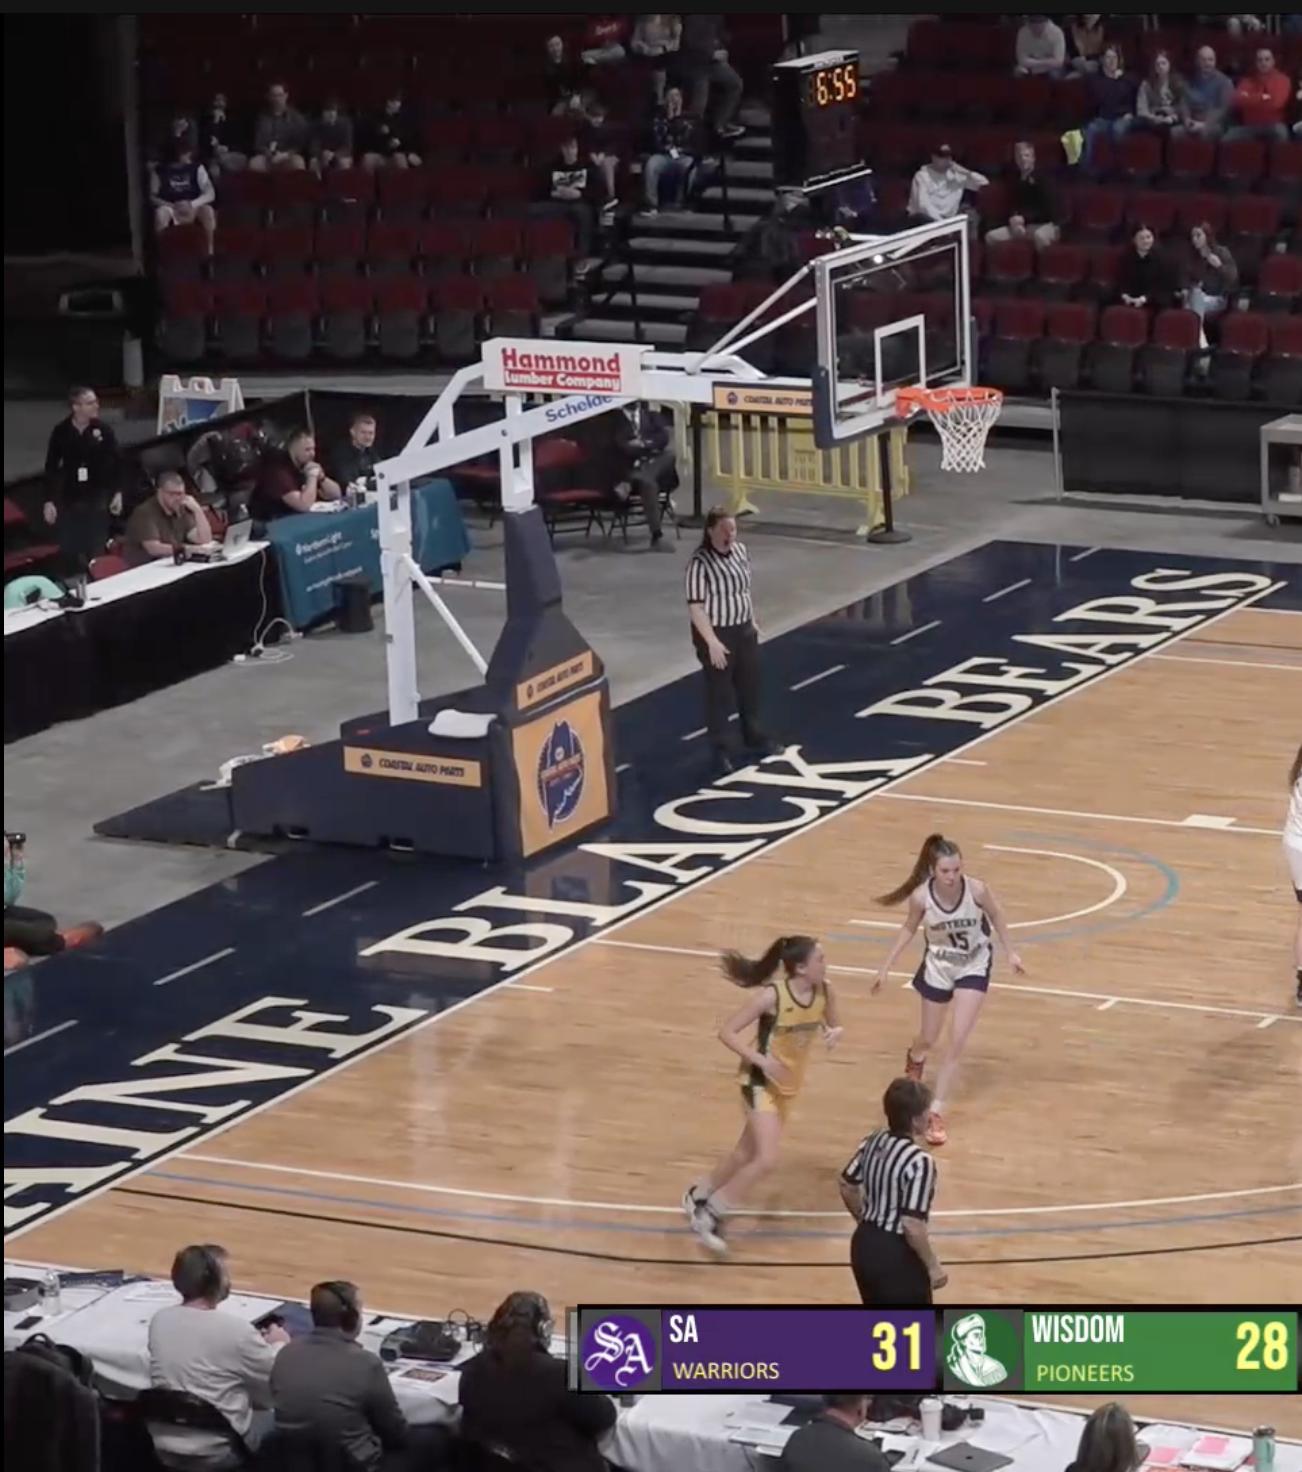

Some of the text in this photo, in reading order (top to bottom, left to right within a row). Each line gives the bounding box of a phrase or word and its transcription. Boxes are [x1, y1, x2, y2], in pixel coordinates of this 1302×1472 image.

[817, 65, 857, 105] 6:55
[501, 347, 621, 373] Hammond
[505, 371, 621, 391] Lumber Company
[854, 568, 1272, 730] BEARS
[415, 762, 439, 774] AUTO
[358, 745, 936, 973] BLACK
[948, 930, 970, 951] 15
